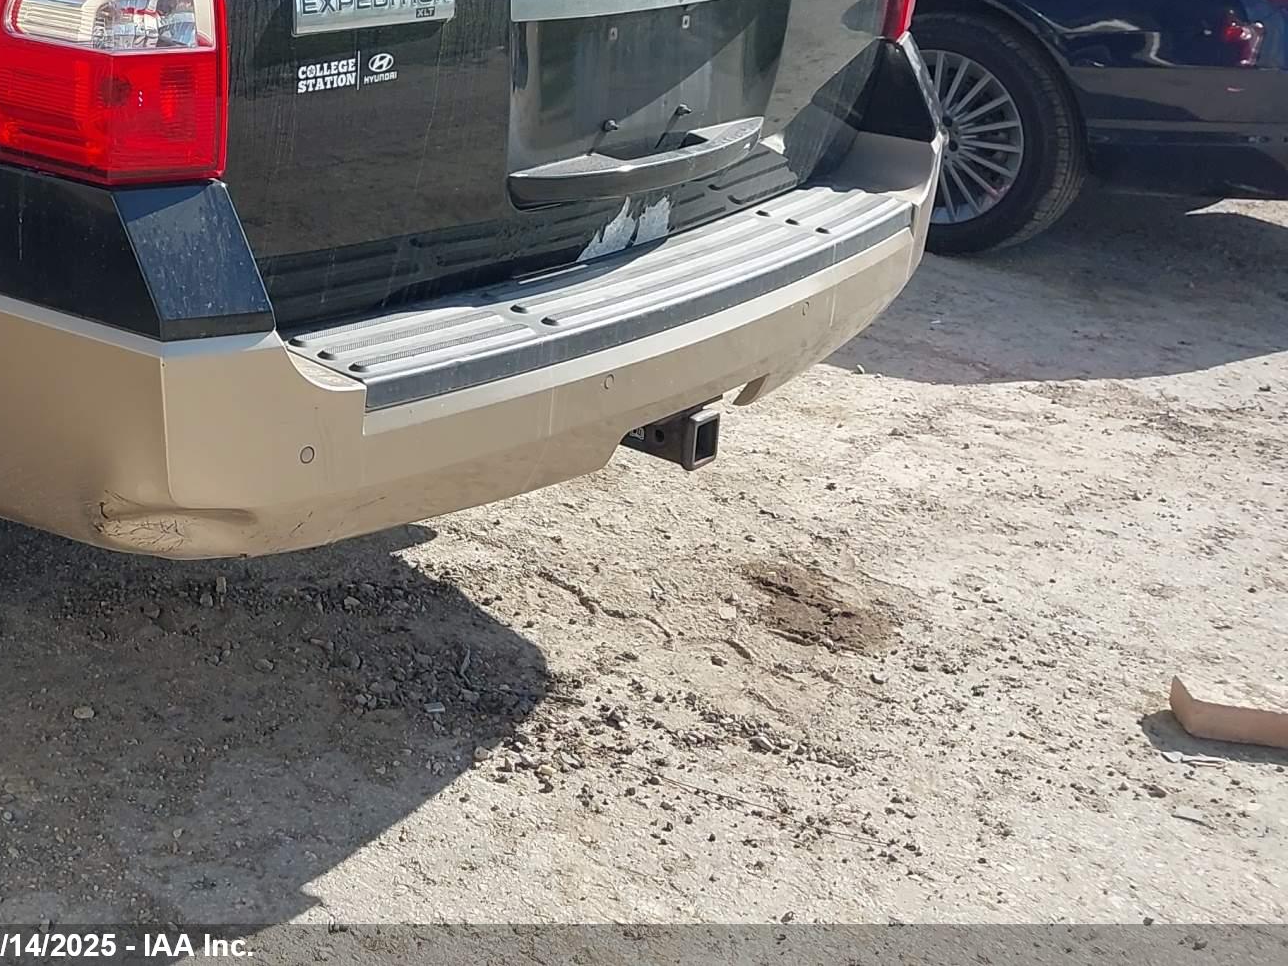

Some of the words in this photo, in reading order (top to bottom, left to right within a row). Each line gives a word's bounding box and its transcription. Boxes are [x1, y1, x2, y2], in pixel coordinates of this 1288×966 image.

[416, 7, 435, 18] XLT
[297, 58, 357, 80] COLLEGE
[363, 71, 398, 85] HYUNDAI
[297, 72, 357, 94] STATION
